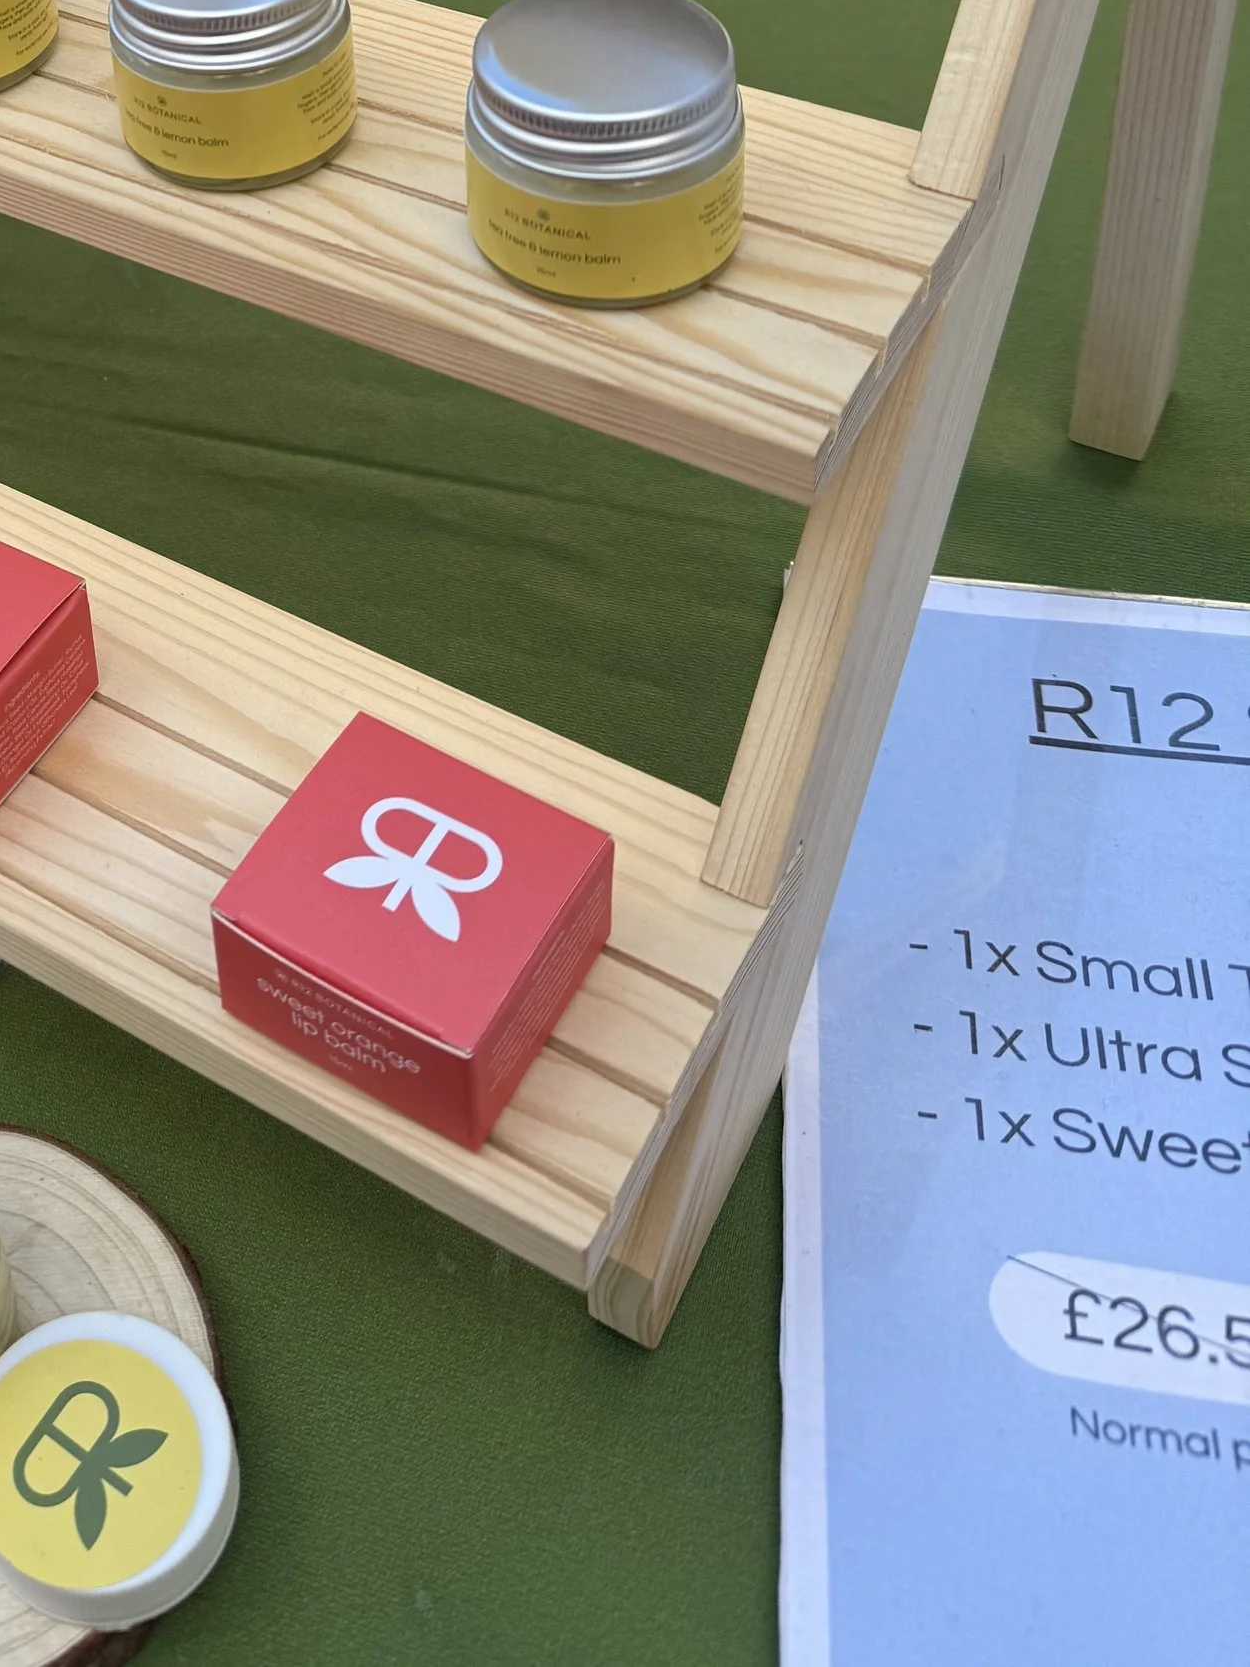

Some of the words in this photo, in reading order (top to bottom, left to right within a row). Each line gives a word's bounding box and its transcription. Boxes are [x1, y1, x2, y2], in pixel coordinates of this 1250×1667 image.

[1031, 678, 1220, 751] R12
[954, 929, 1020, 976] 1x
[1036, 940, 1214, 1000] Small
[959, 1010, 1027, 1062] 1x
[1044, 1023, 1202, 1081] Ultra
[964, 1097, 1035, 1147] 1x
[1070, 1405, 1221, 1461] Normal
